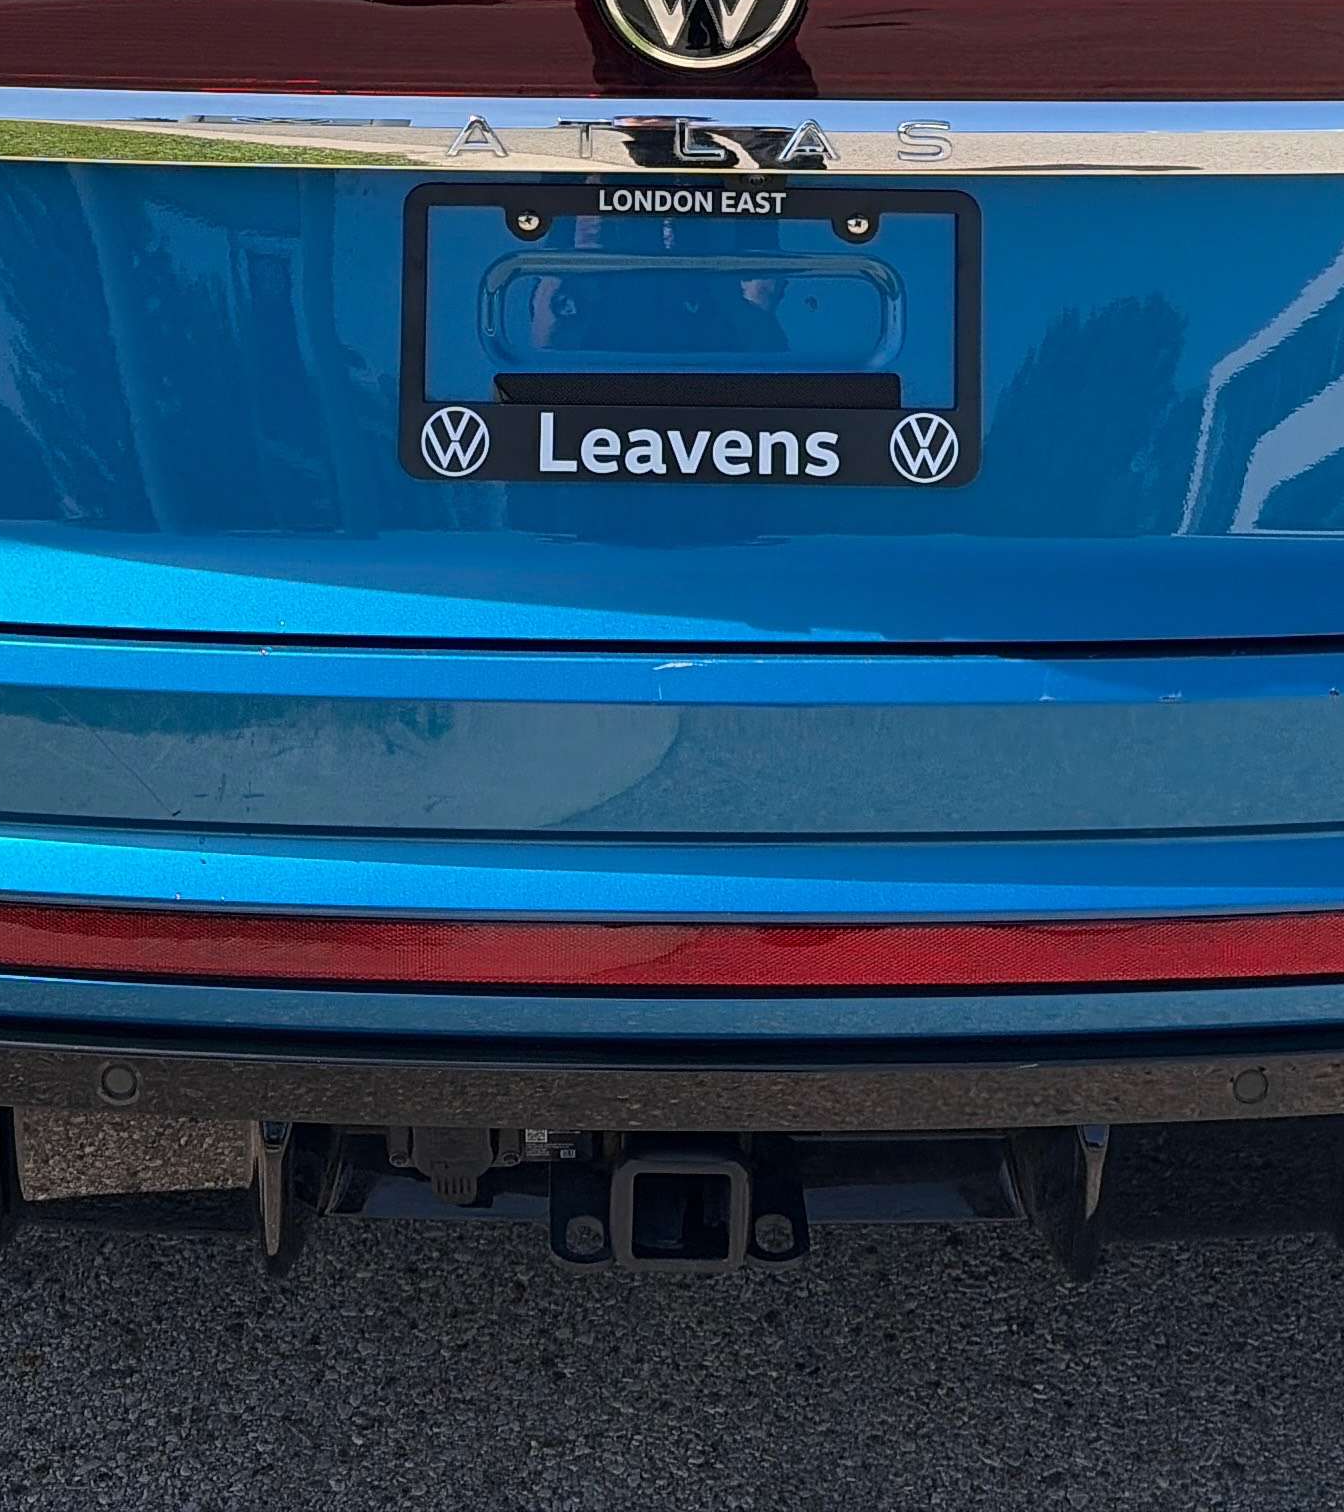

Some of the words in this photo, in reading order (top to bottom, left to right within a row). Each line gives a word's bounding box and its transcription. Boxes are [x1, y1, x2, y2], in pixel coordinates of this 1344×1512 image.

[446, 114, 953, 163] ATLAS
[598, 188, 713, 214] LONDON
[720, 191, 787, 214] EAST
[539, 412, 840, 477] Leavens
